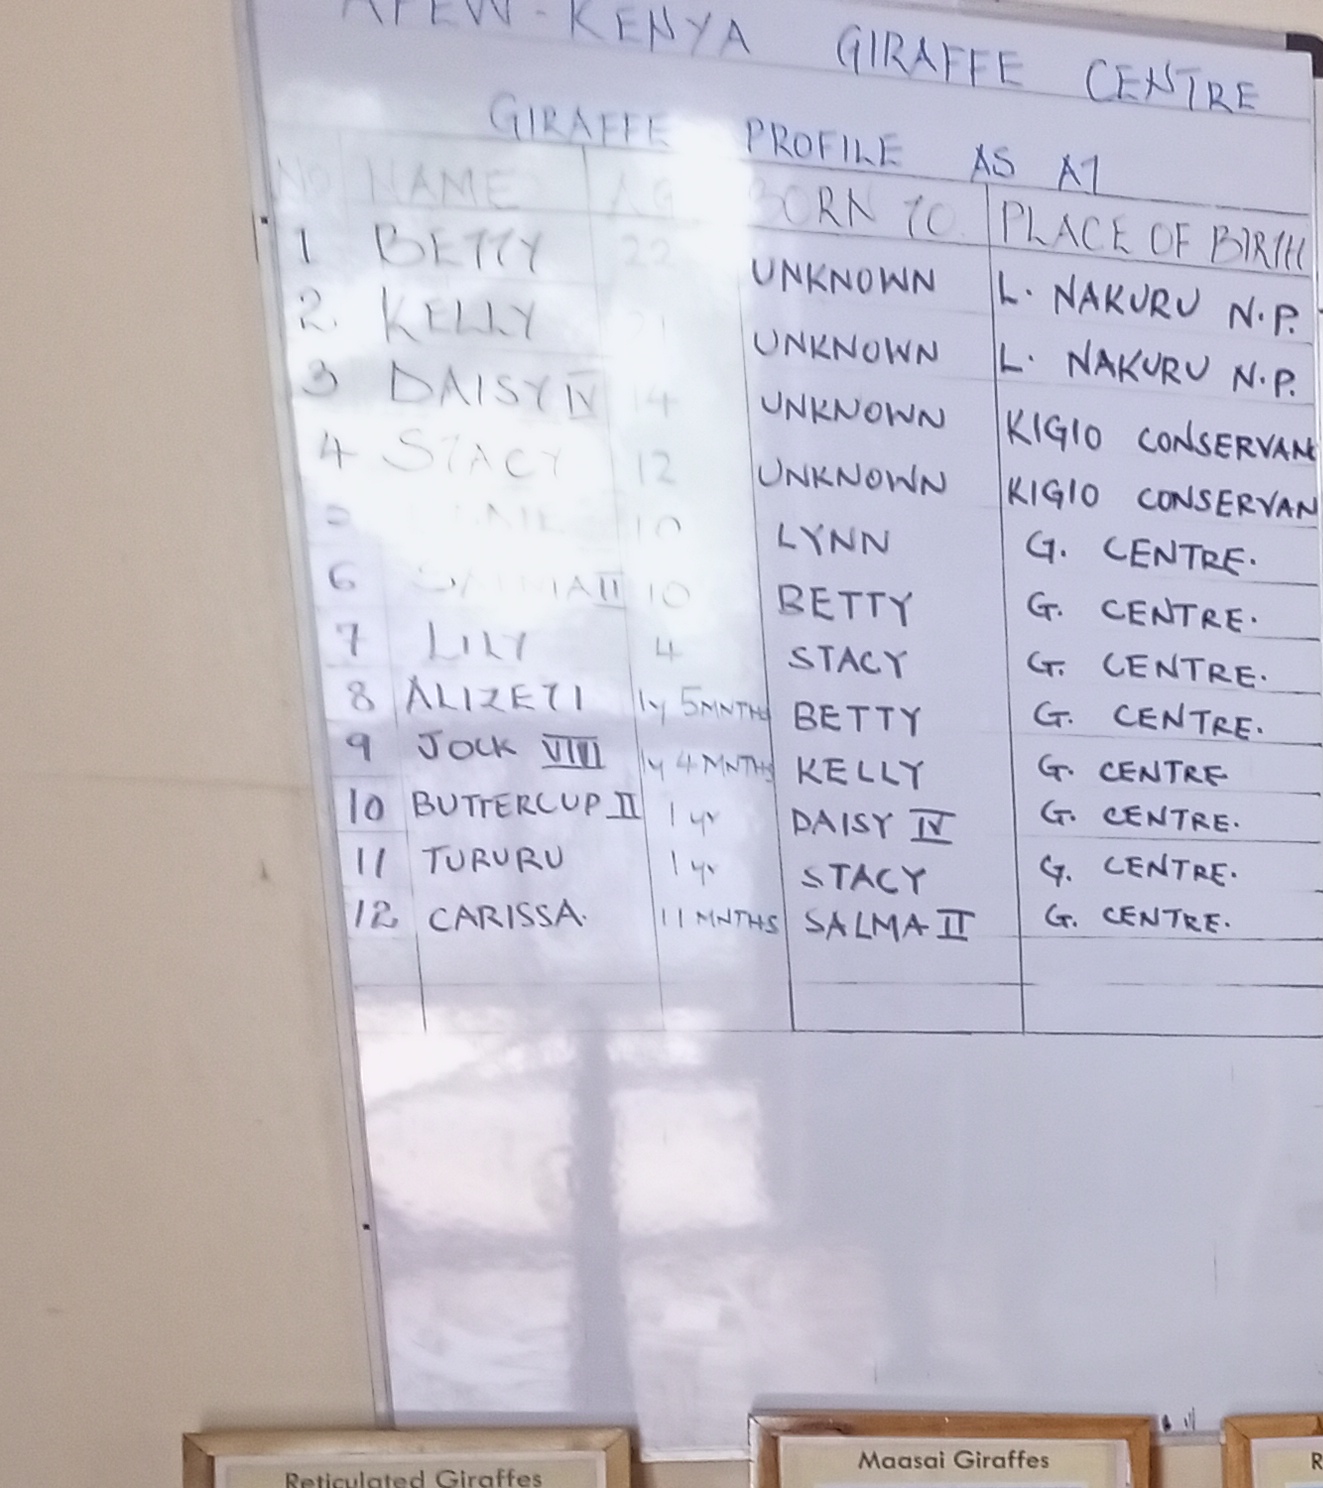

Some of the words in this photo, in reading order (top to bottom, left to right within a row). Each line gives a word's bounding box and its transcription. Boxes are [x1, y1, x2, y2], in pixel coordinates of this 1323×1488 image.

[570, 0, 751, 57] KENYA
[836, 24, 1024, 88] GIRAFFE
[1086, 58, 1261, 113] CENTRE
[489, 92, 670, 147] GIRAFFE
[744, 117, 904, 168] PROFILE
[969, 143, 1015, 183] AS
[1057, 154, 1101, 195] AT
[366, 156, 520, 211] NAME
[750, 178, 876, 230] BORN
[1001, 199, 1130, 256] PLACE
[1150, 220, 1191, 258] OF
[1209, 224, 1307, 272] BIRTH
[373, 222, 544, 274] BETTY
[621, 232, 673, 268] 22
[751, 256, 936, 294] UNKNOWN
[997, 269, 1034, 306] L.
[1053, 273, 1202, 320] NAKURU
[1227, 295, 1301, 336] N.P.
[381, 286, 537, 343] KELLY
[752, 328, 940, 365] UNKNOWN
[999, 342, 1035, 375] L.
[1067, 339, 1210, 385] NAKURU
[1231, 361, 1297, 399] N.P.
[301, 358, 339, 398] 3
[390, 359, 552, 415] DAISY
[760, 390, 947, 430] UNKNOWN
[1006, 408, 1104, 451] KIGIO
[318, 431, 360, 471] 4
[382, 429, 565, 480] STACY
[637, 449, 679, 488] 12
[758, 464, 948, 497] UNKNOWN
[1005, 476, 1101, 510] KIGIO
[1137, 484, 1319, 520] CONSERVAN
[635, 513, 683, 546] 10
[777, 521, 892, 557] LYNN
[1025, 529, 1067, 565] G.
[1102, 534, 1258, 578] CENTRE.
[327, 559, 362, 592] 6
[777, 582, 913, 628] BETTY
[1026, 590, 1064, 622] G.
[1100, 598, 1258, 634] CENTRE.
[335, 621, 361, 657] 7
[427, 618, 528, 662] LILY
[655, 635, 684, 665] 4
[788, 644, 909, 680] STACY
[1026, 650, 1066, 679] G.
[1102, 651, 1269, 689] CENTRE.
[346, 680, 376, 713] 8
[404, 674, 584, 714] ALIZETI
[793, 701, 922, 738] BETTY
[1032, 701, 1073, 729] G.
[1112, 703, 1264, 741] CENTRE.
[344, 731, 372, 763] 9
[416, 731, 519, 764] JOCK
[796, 756, 925, 791] KELLY
[1037, 752, 1075, 783] G.
[348, 787, 386, 825] 10
[411, 789, 602, 820] BUTTERCUP
[792, 807, 894, 840] DAISY
[1040, 799, 1079, 827] G.
[1102, 803, 1241, 834] CENTRE.
[356, 845, 387, 880] 11
[421, 844, 566, 876] TURURU
[800, 862, 928, 896] STACY
[1039, 854, 1073, 887] G.
[1103, 852, 1239, 888] CENTRE.
[353, 899, 399, 930] 12
[661, 907, 684, 929] 11
[695, 909, 782, 935] MNTHS
[804, 909, 930, 943] SALMA
[1044, 902, 1079, 930] G.
[1101, 903, 1232, 935] CENTRE.
[858, 1449, 946, 1471] Maasai
[953, 1449, 1050, 1471] Giraffes
